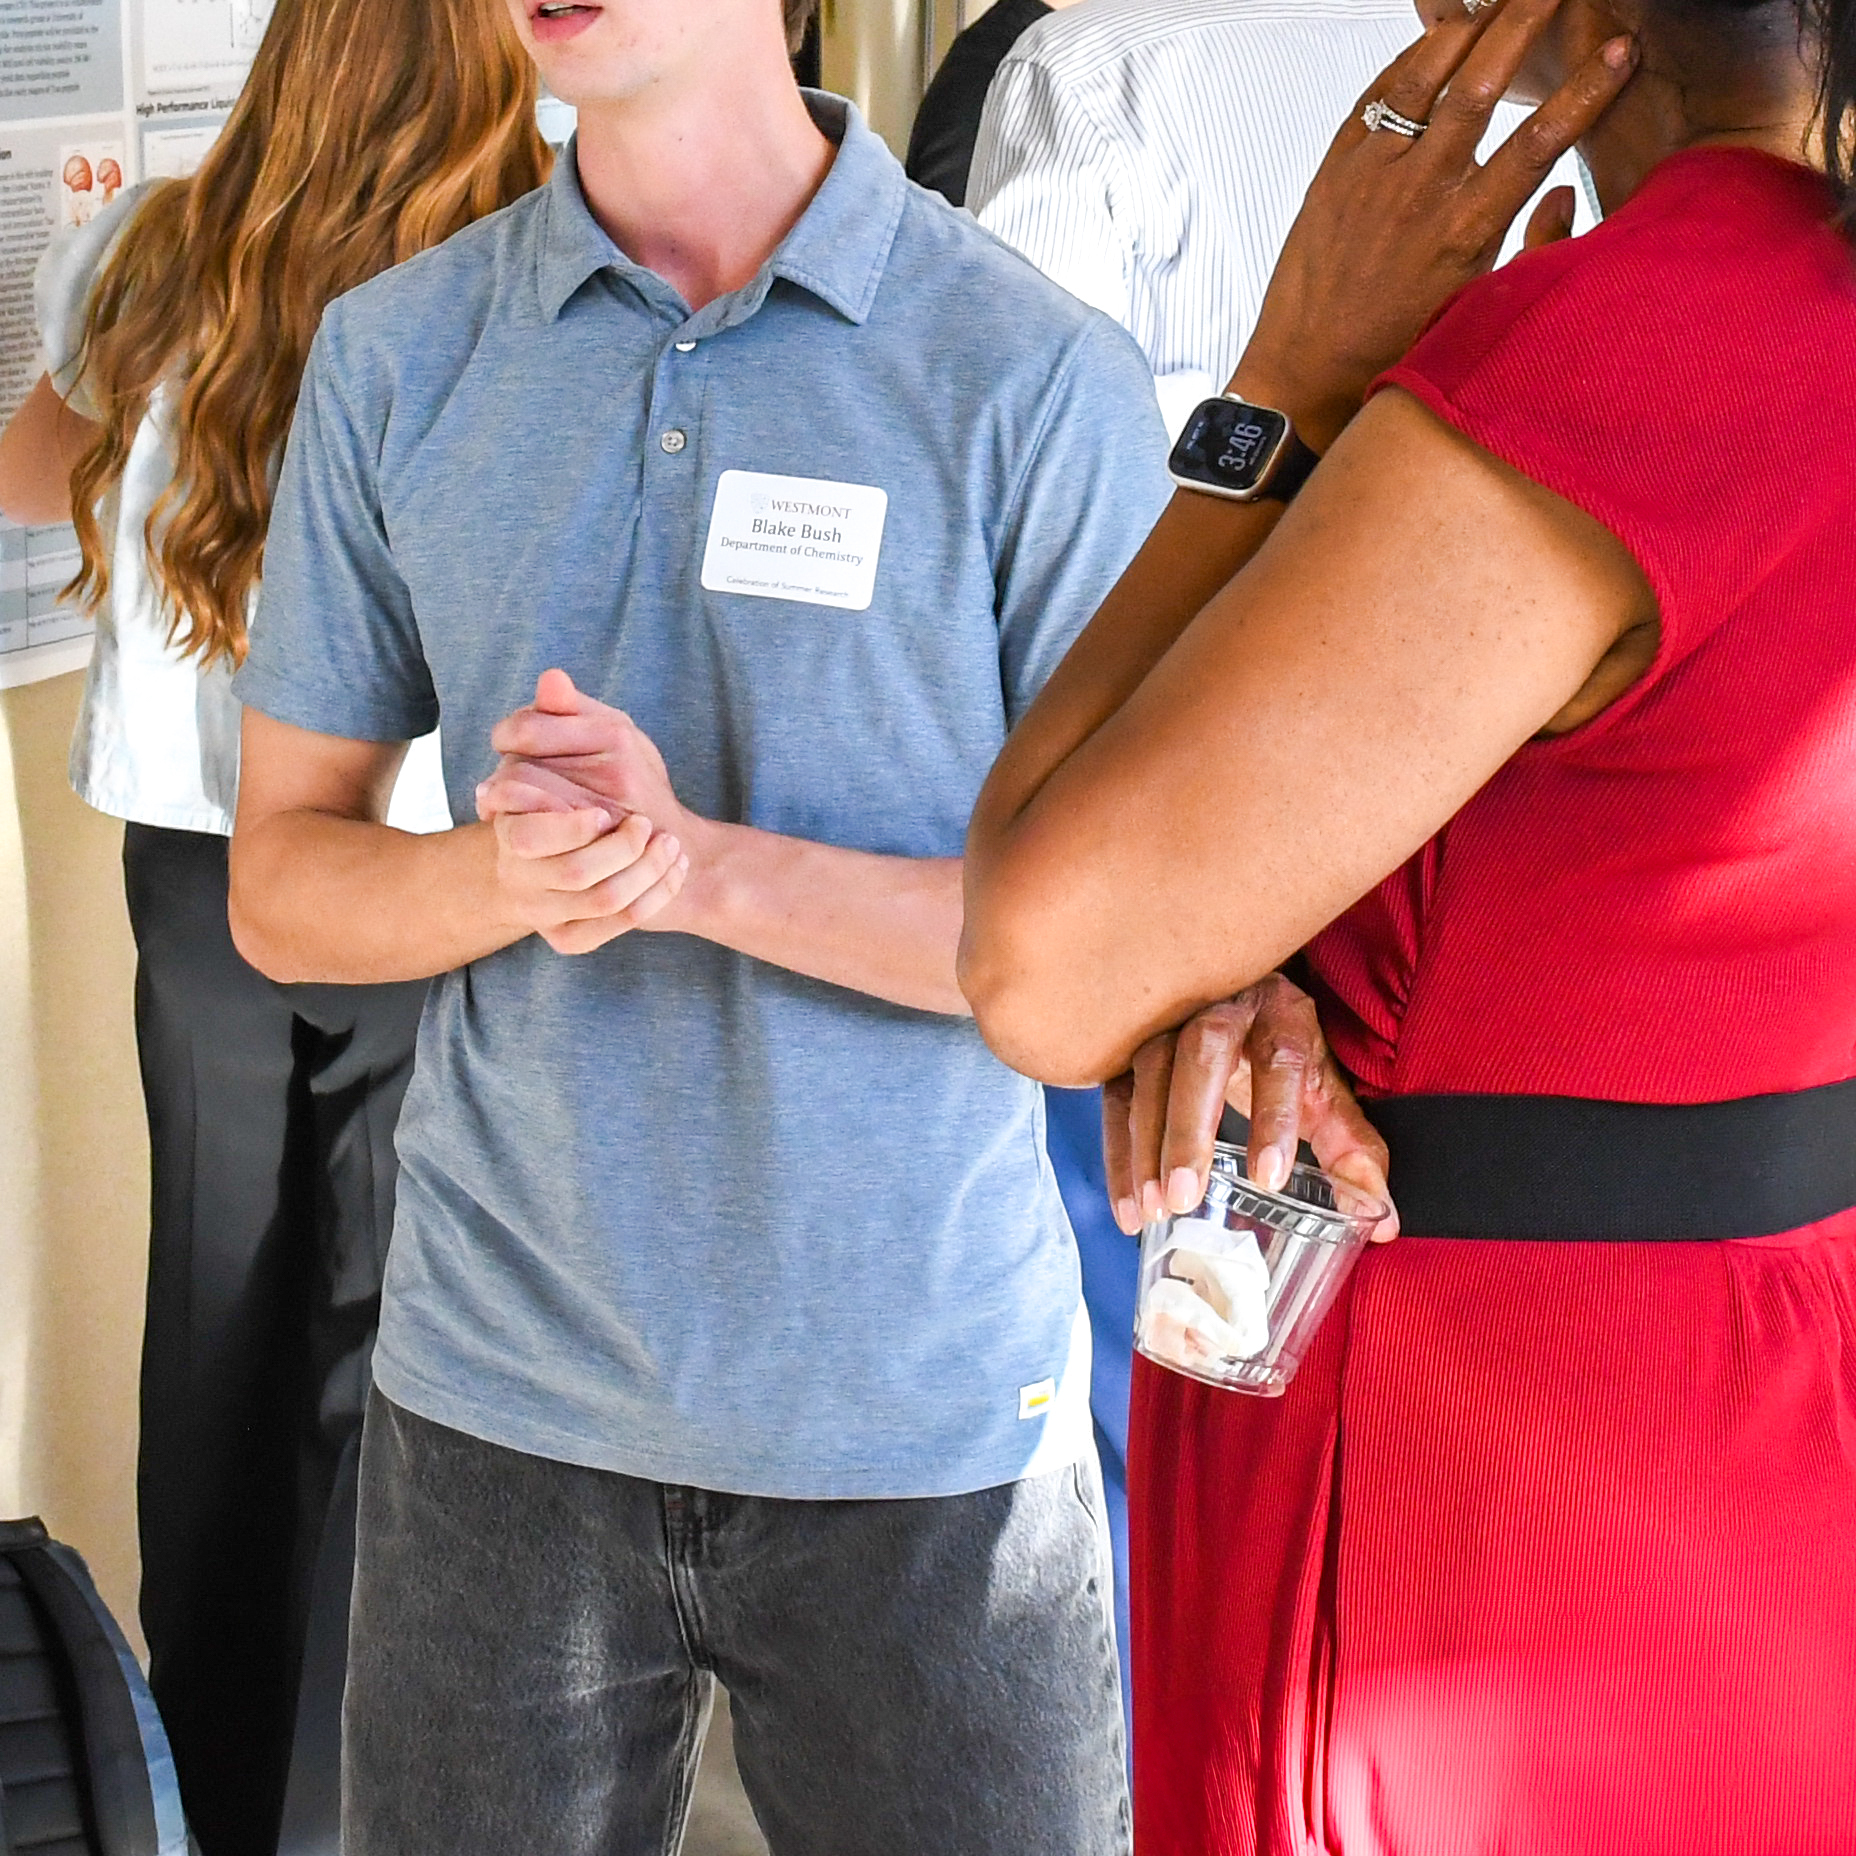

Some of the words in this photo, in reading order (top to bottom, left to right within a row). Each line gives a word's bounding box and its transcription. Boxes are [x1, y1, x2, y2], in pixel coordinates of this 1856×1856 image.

[136, 102, 154, 118] High
[156, 99, 210, 115] Performance
[1217, 422, 1263, 472] 3:46
[770, 499, 852, 519] WESTMONT
[751, 518, 796, 537] Blake
[801, 523, 842, 544] Bush
[720, 536, 787, 555] Department
[790, 544, 802, 556] of
[803, 546, 864, 566] Chemistry
[726, 575, 769, 589] Celebration
[781, 581, 813, 594] Summer
